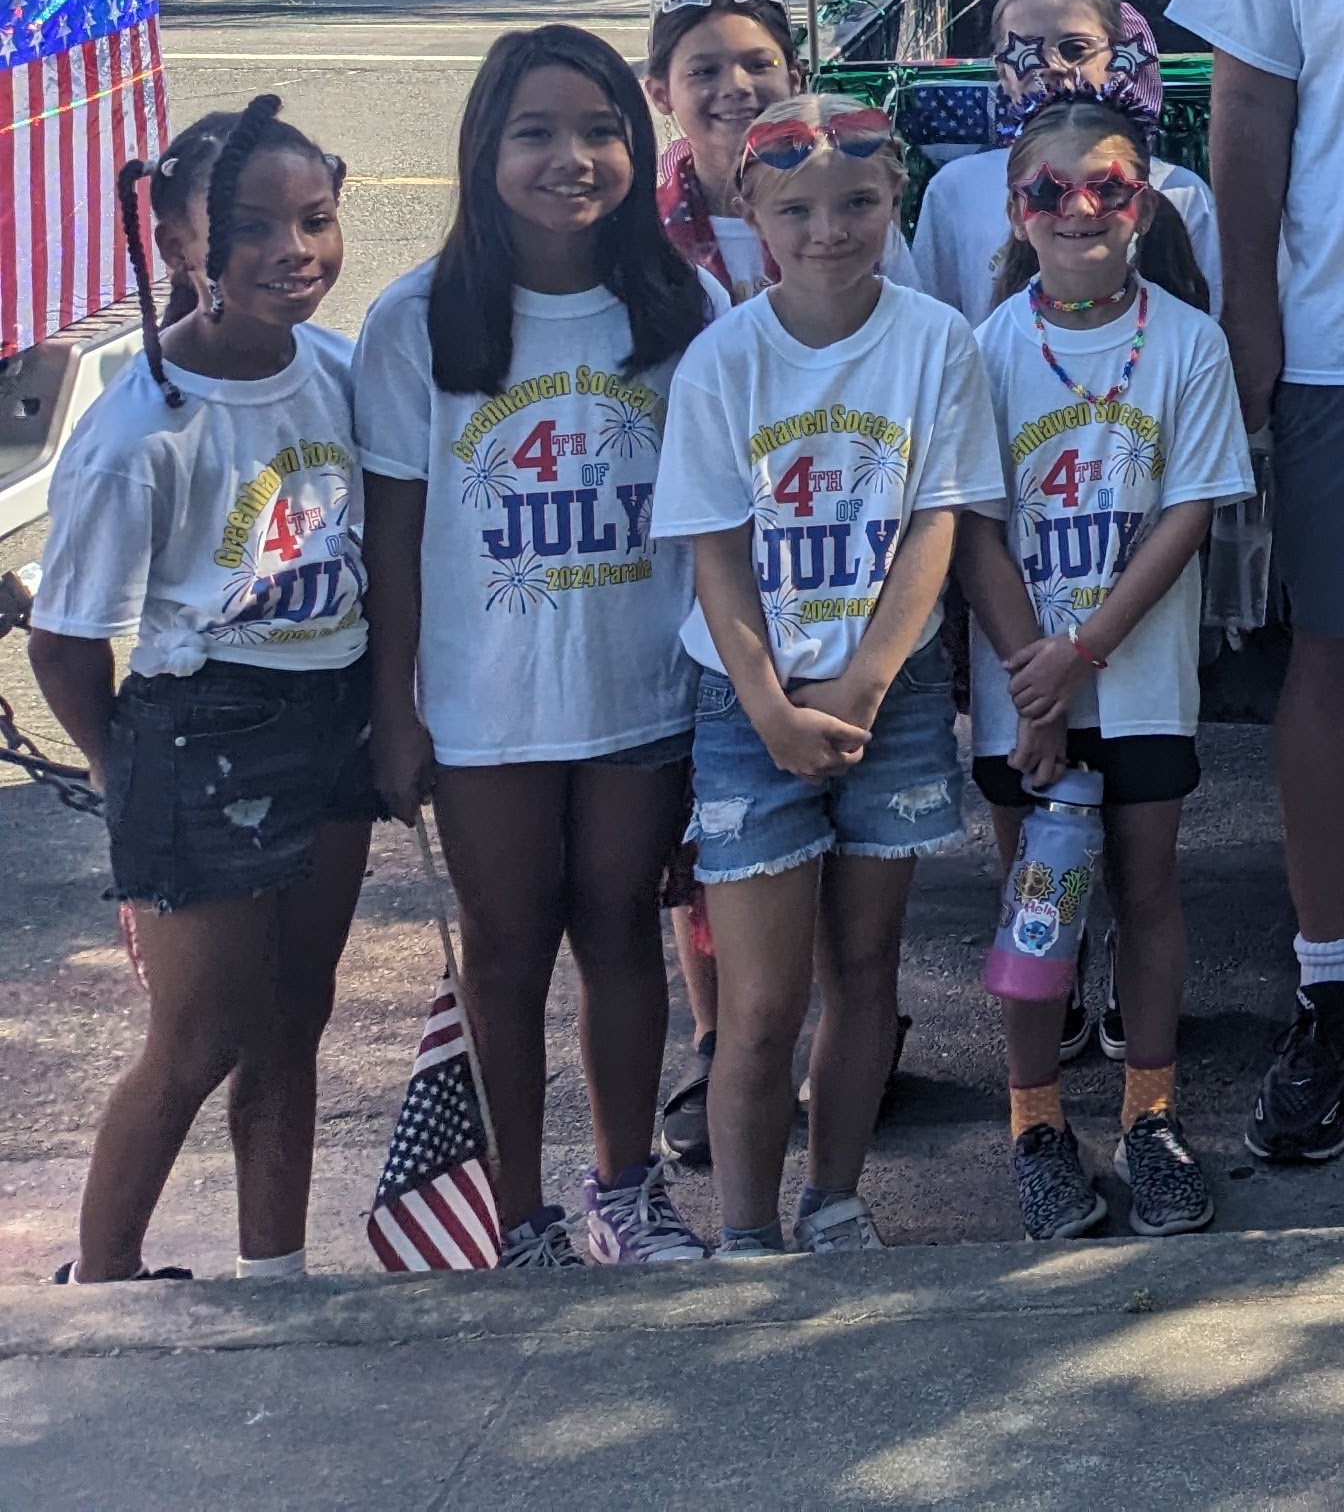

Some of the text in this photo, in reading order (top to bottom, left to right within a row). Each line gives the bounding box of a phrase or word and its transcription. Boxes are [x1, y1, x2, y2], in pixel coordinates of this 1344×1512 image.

[511, 420, 587, 482] 4TH
[582, 463, 610, 486] OF
[1040, 449, 1103, 508] 4TH
[773, 456, 843, 518] 4TH
[836, 499, 863, 522] OF
[263, 498, 326, 562] 4TH
[482, 482, 652, 560] JULY
[546, 565, 596, 591] 2024
[757, 519, 900, 592] JULY
[801, 598, 844, 624] 2024
[1024, 900, 1057, 918] Hello
